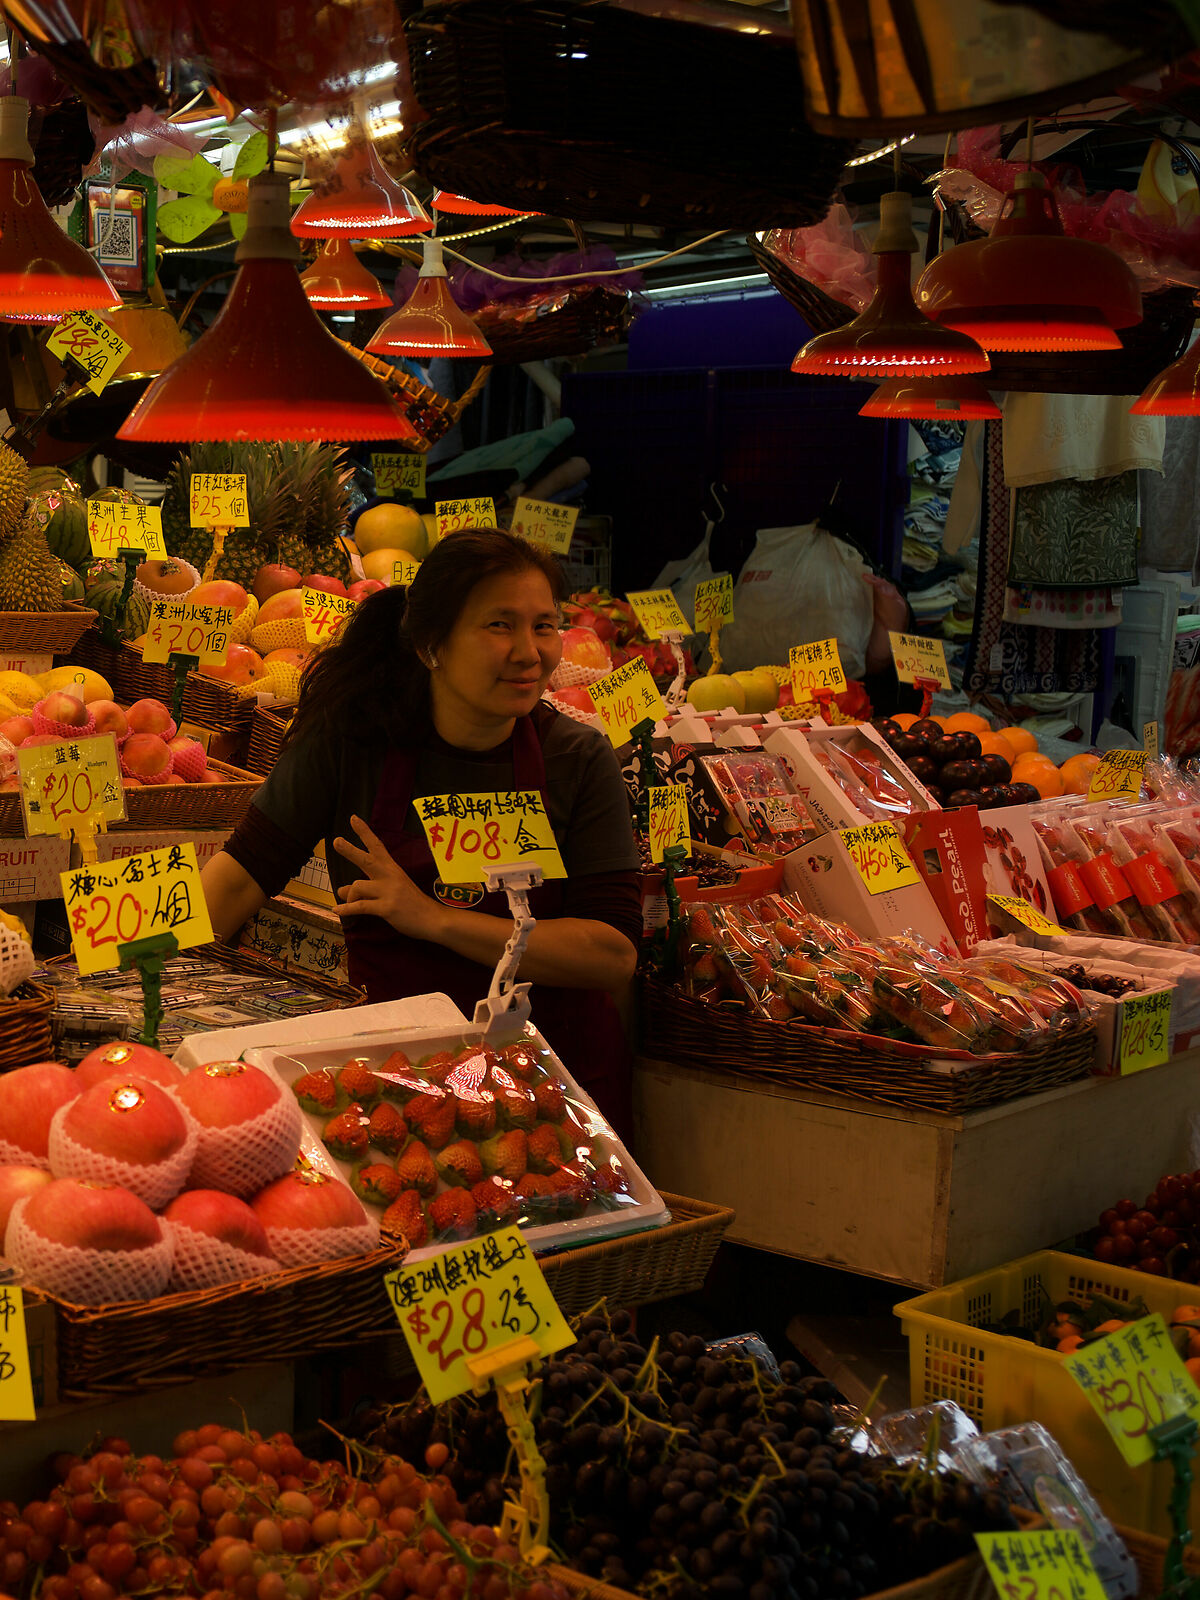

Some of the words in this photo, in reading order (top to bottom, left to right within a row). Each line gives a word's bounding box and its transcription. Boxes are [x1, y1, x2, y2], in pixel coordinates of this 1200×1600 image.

[68, 845, 193, 906] 糖心富士果
[438, 886, 480, 903] JCT
